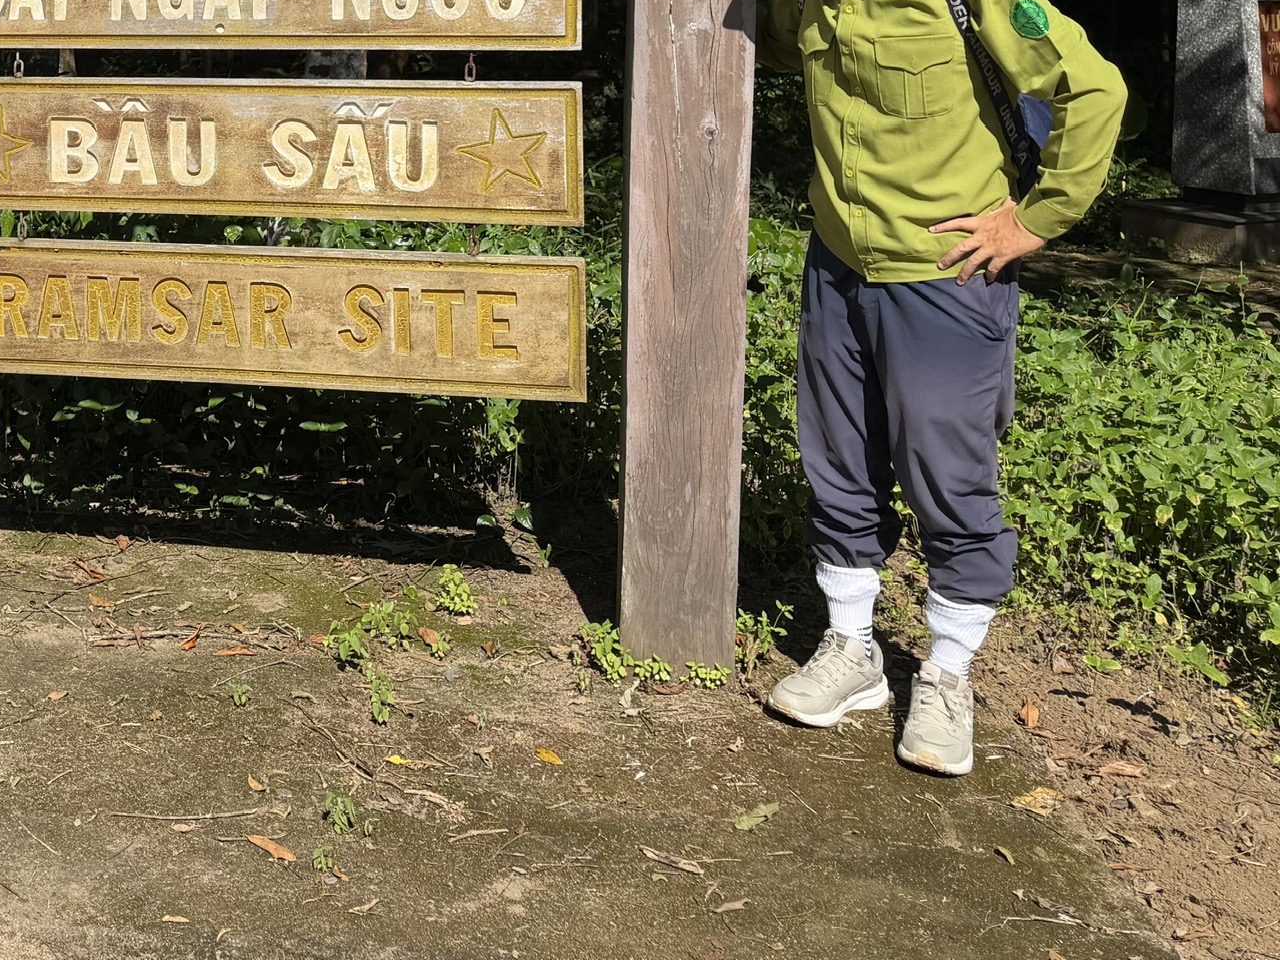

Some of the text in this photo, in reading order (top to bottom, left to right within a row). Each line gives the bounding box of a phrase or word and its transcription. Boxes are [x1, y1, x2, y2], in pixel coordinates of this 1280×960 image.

[49, 98, 438, 192] BẦU SẤU
[338, 285, 519, 361] SITE
